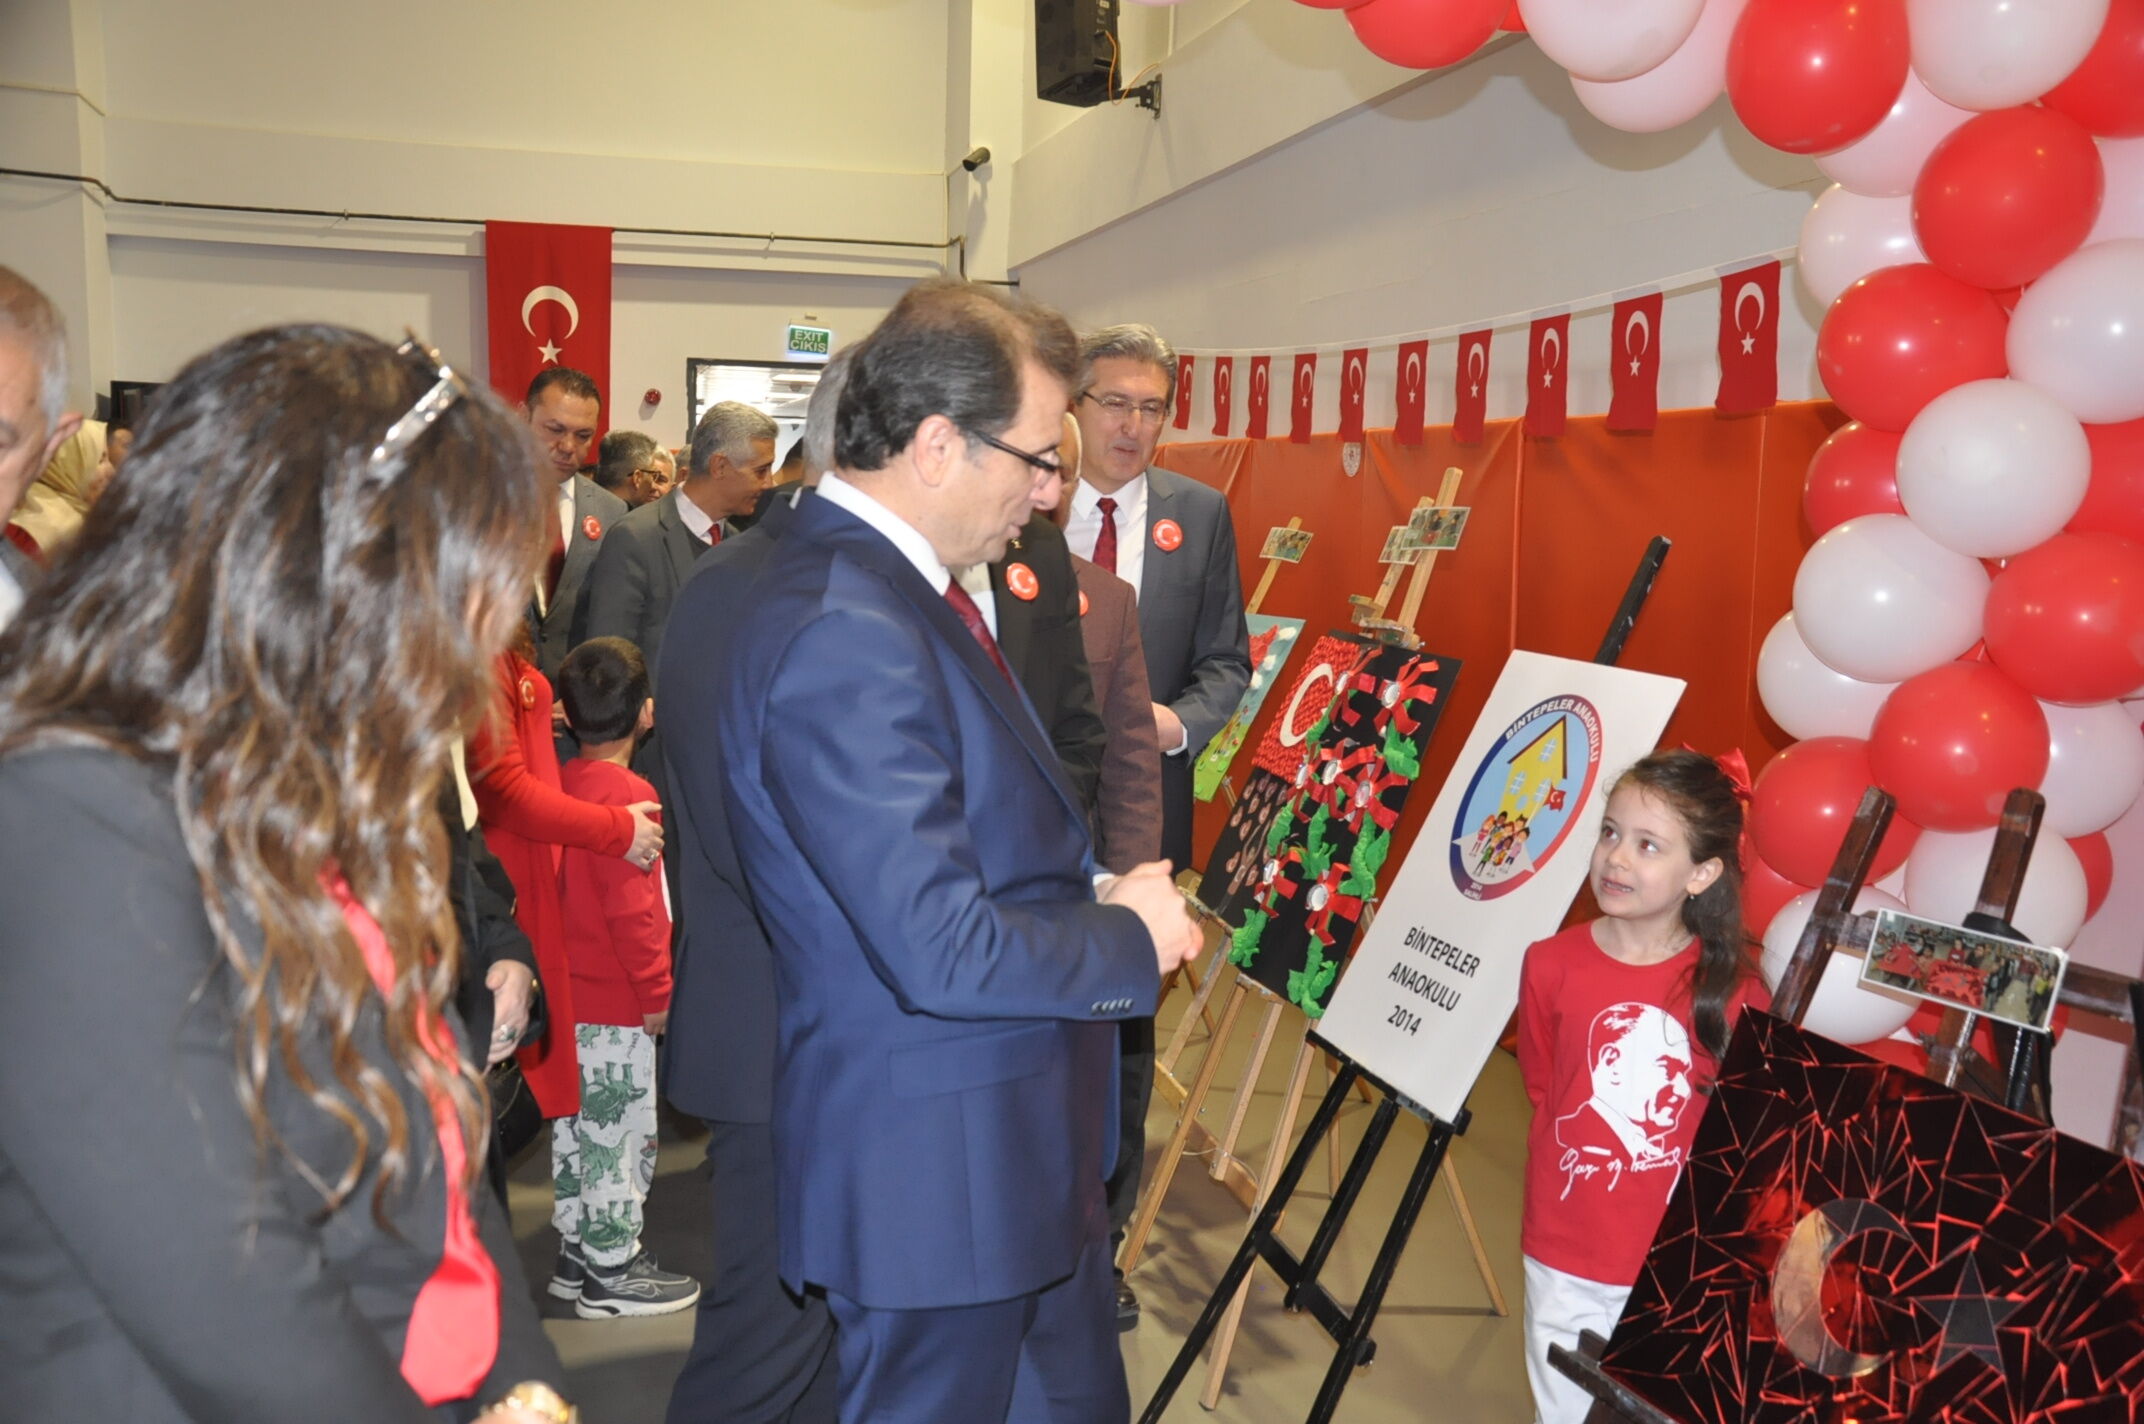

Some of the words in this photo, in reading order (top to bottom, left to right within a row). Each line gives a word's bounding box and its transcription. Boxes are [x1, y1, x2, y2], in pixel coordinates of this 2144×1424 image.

[794, 329, 824, 342] EXIT
[1505, 698, 1575, 741] BİNTEPELER
[1573, 702, 1600, 763] ANAOKULU
[1403, 926, 1480, 978] BİNTEPELER
[1388, 962, 1461, 1012] ANAOKULU
[1387, 1004, 1422, 1036] 2014
